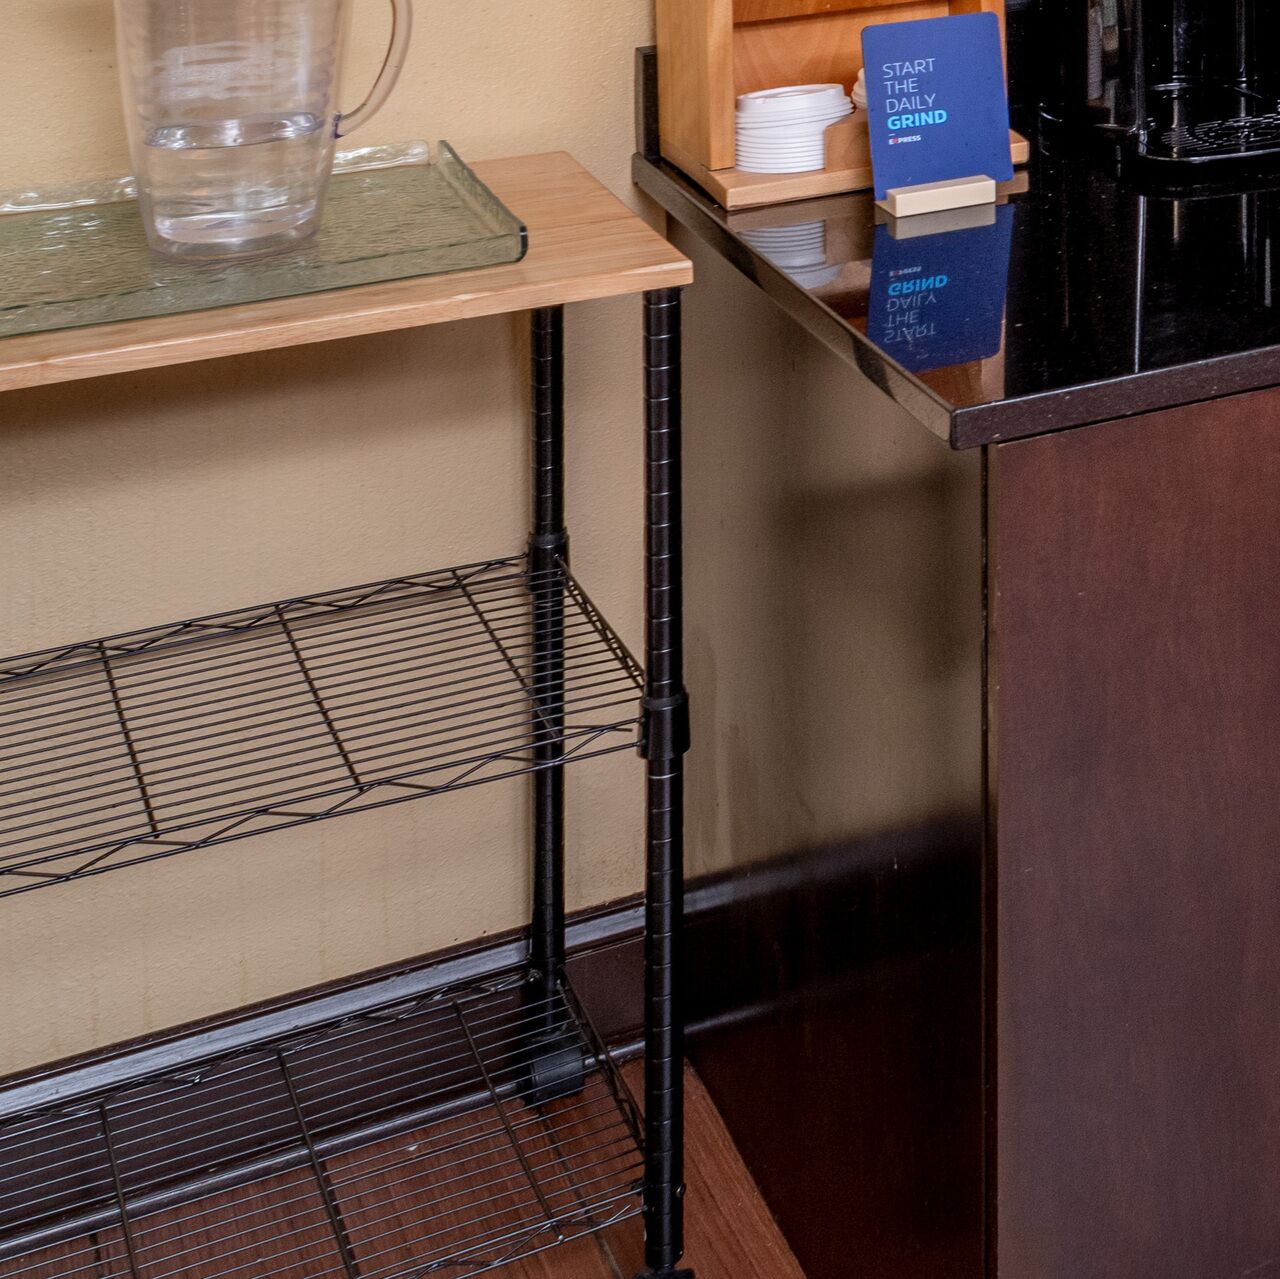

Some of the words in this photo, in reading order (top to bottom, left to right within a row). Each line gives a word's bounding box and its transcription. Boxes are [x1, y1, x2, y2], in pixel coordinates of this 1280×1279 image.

[882, 57, 936, 78] START
[883, 78, 919, 95] THE
[886, 93, 936, 113] DAILY
[887, 109, 947, 130] GRIND
[888, 134, 921, 145] EXPRESS
